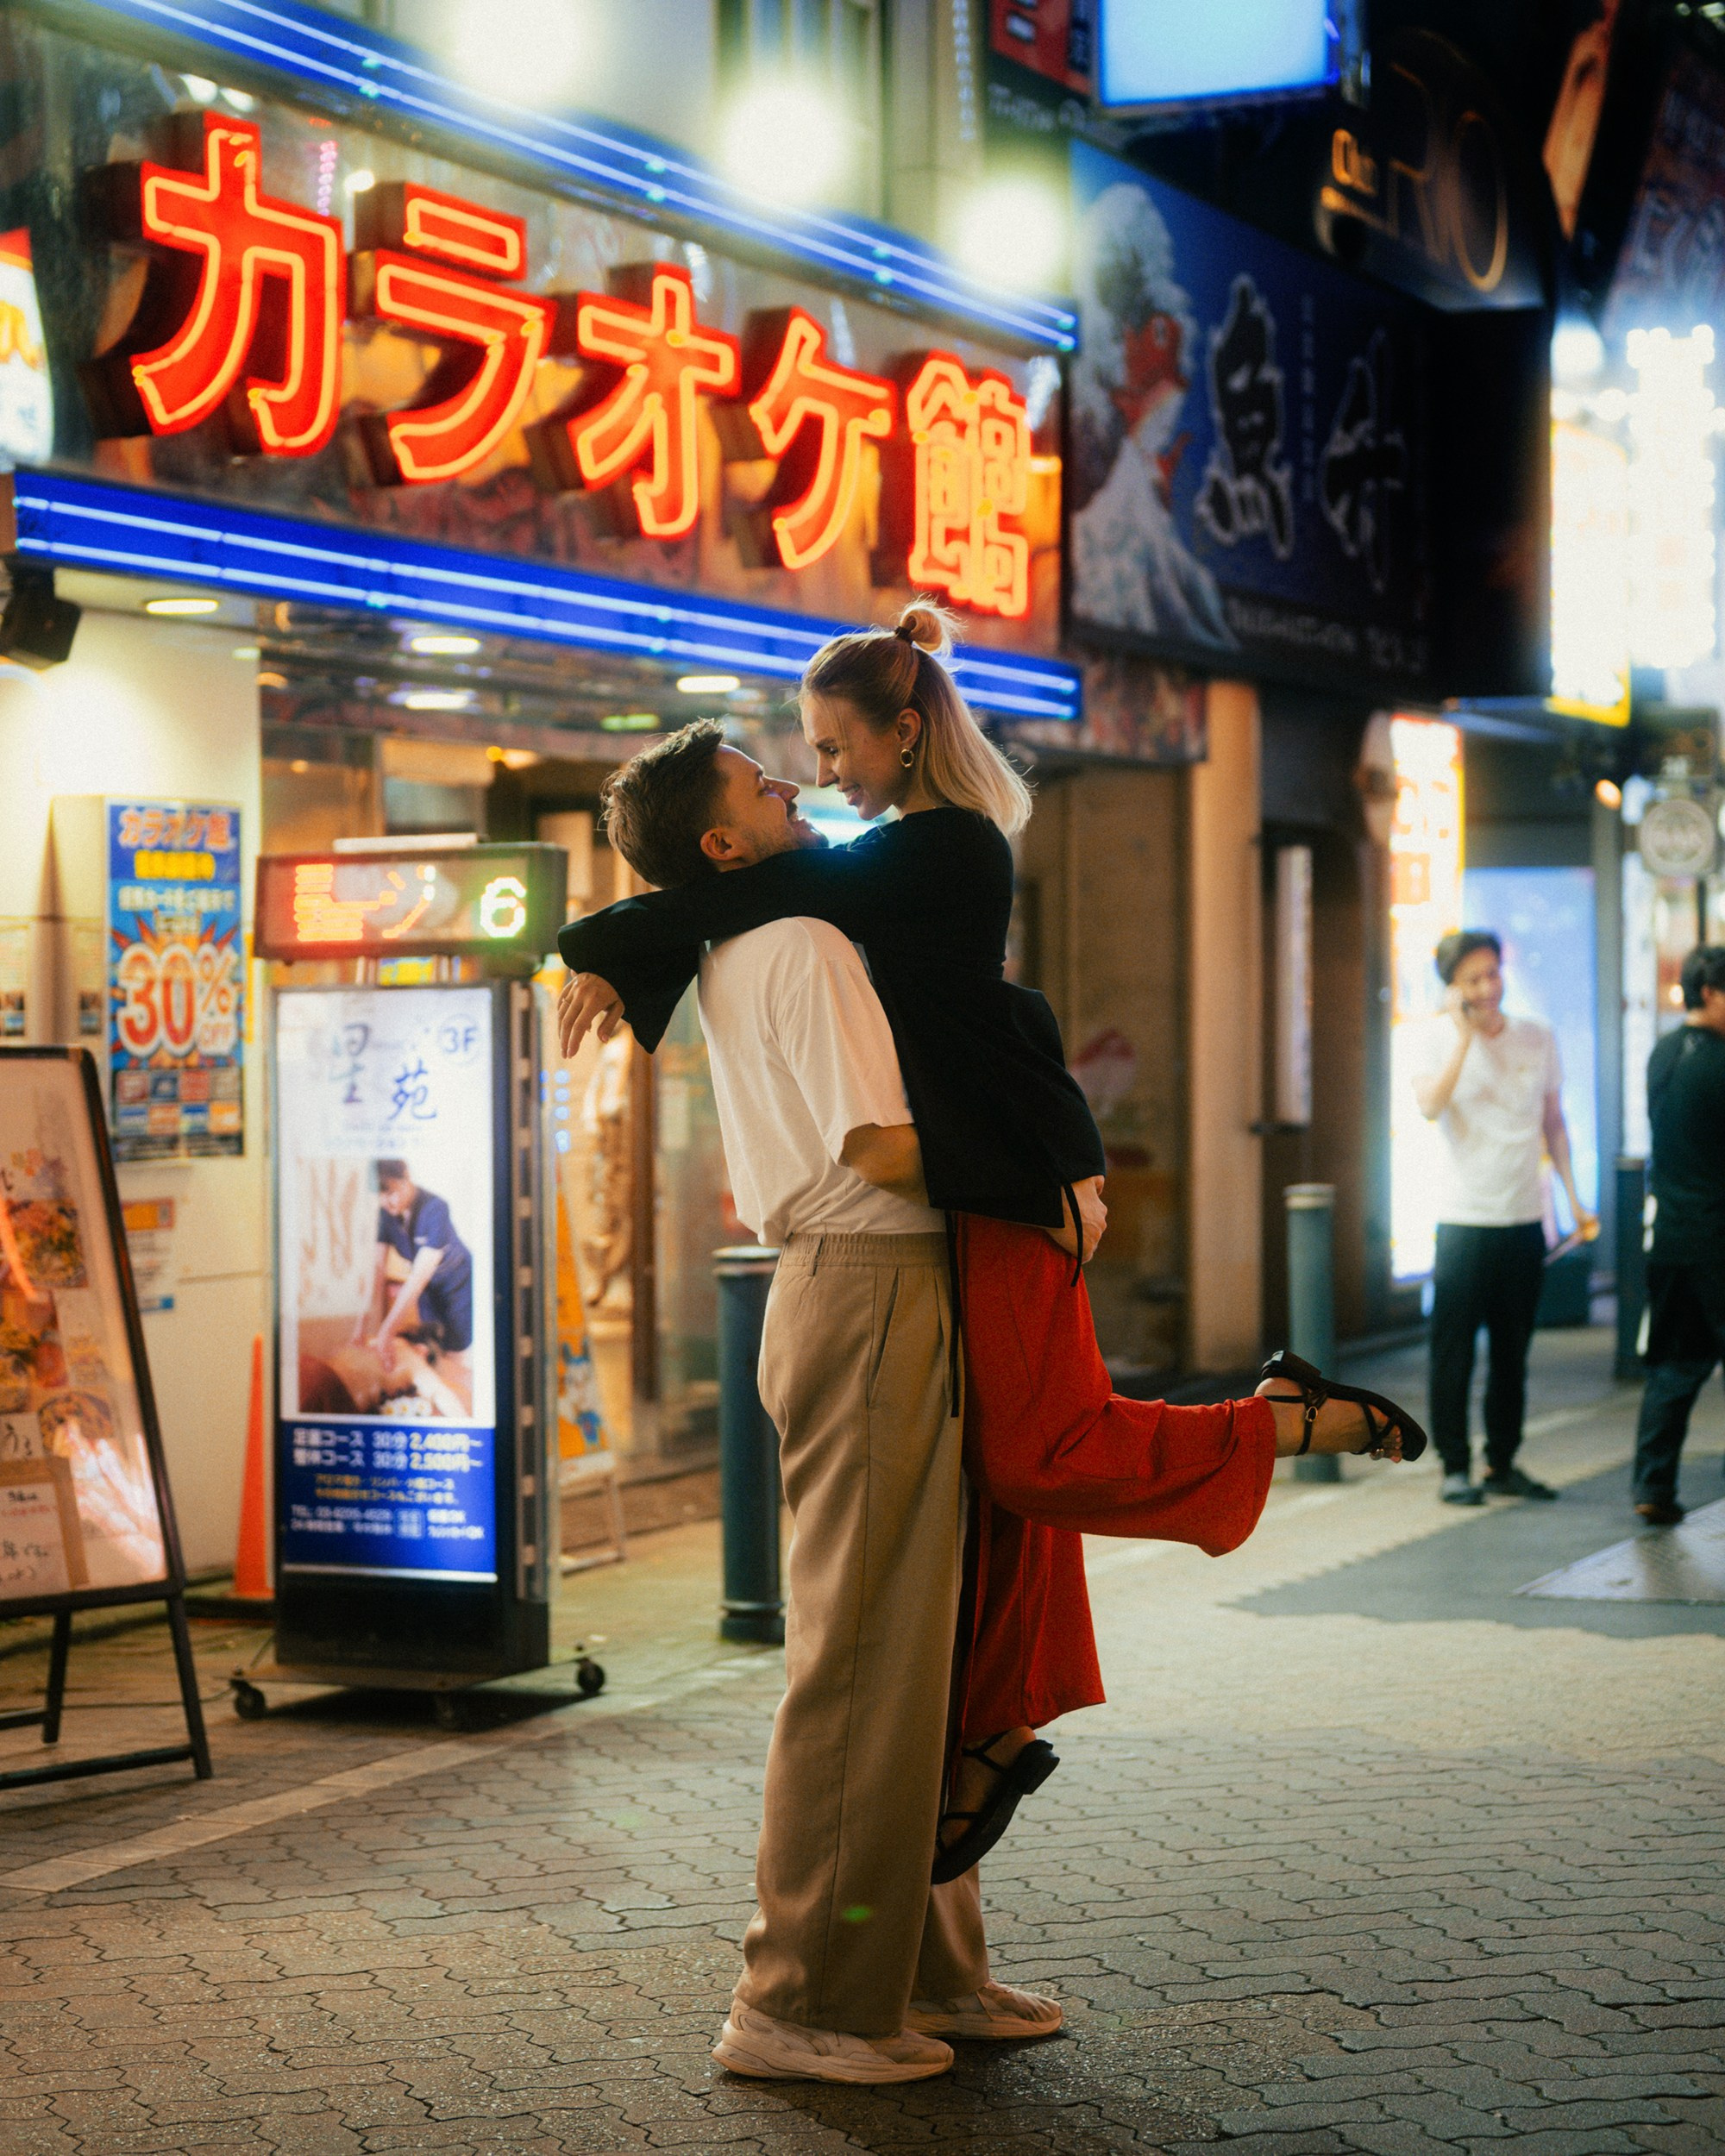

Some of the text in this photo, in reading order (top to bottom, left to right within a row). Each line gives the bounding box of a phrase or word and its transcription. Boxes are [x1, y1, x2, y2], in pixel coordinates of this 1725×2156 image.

[129, 110, 1033, 619] カラオケ館
[119, 807, 231, 849] カラオケ館
[122, 948, 234, 1049] 30%
[440, 1025, 480, 1054] 3F
